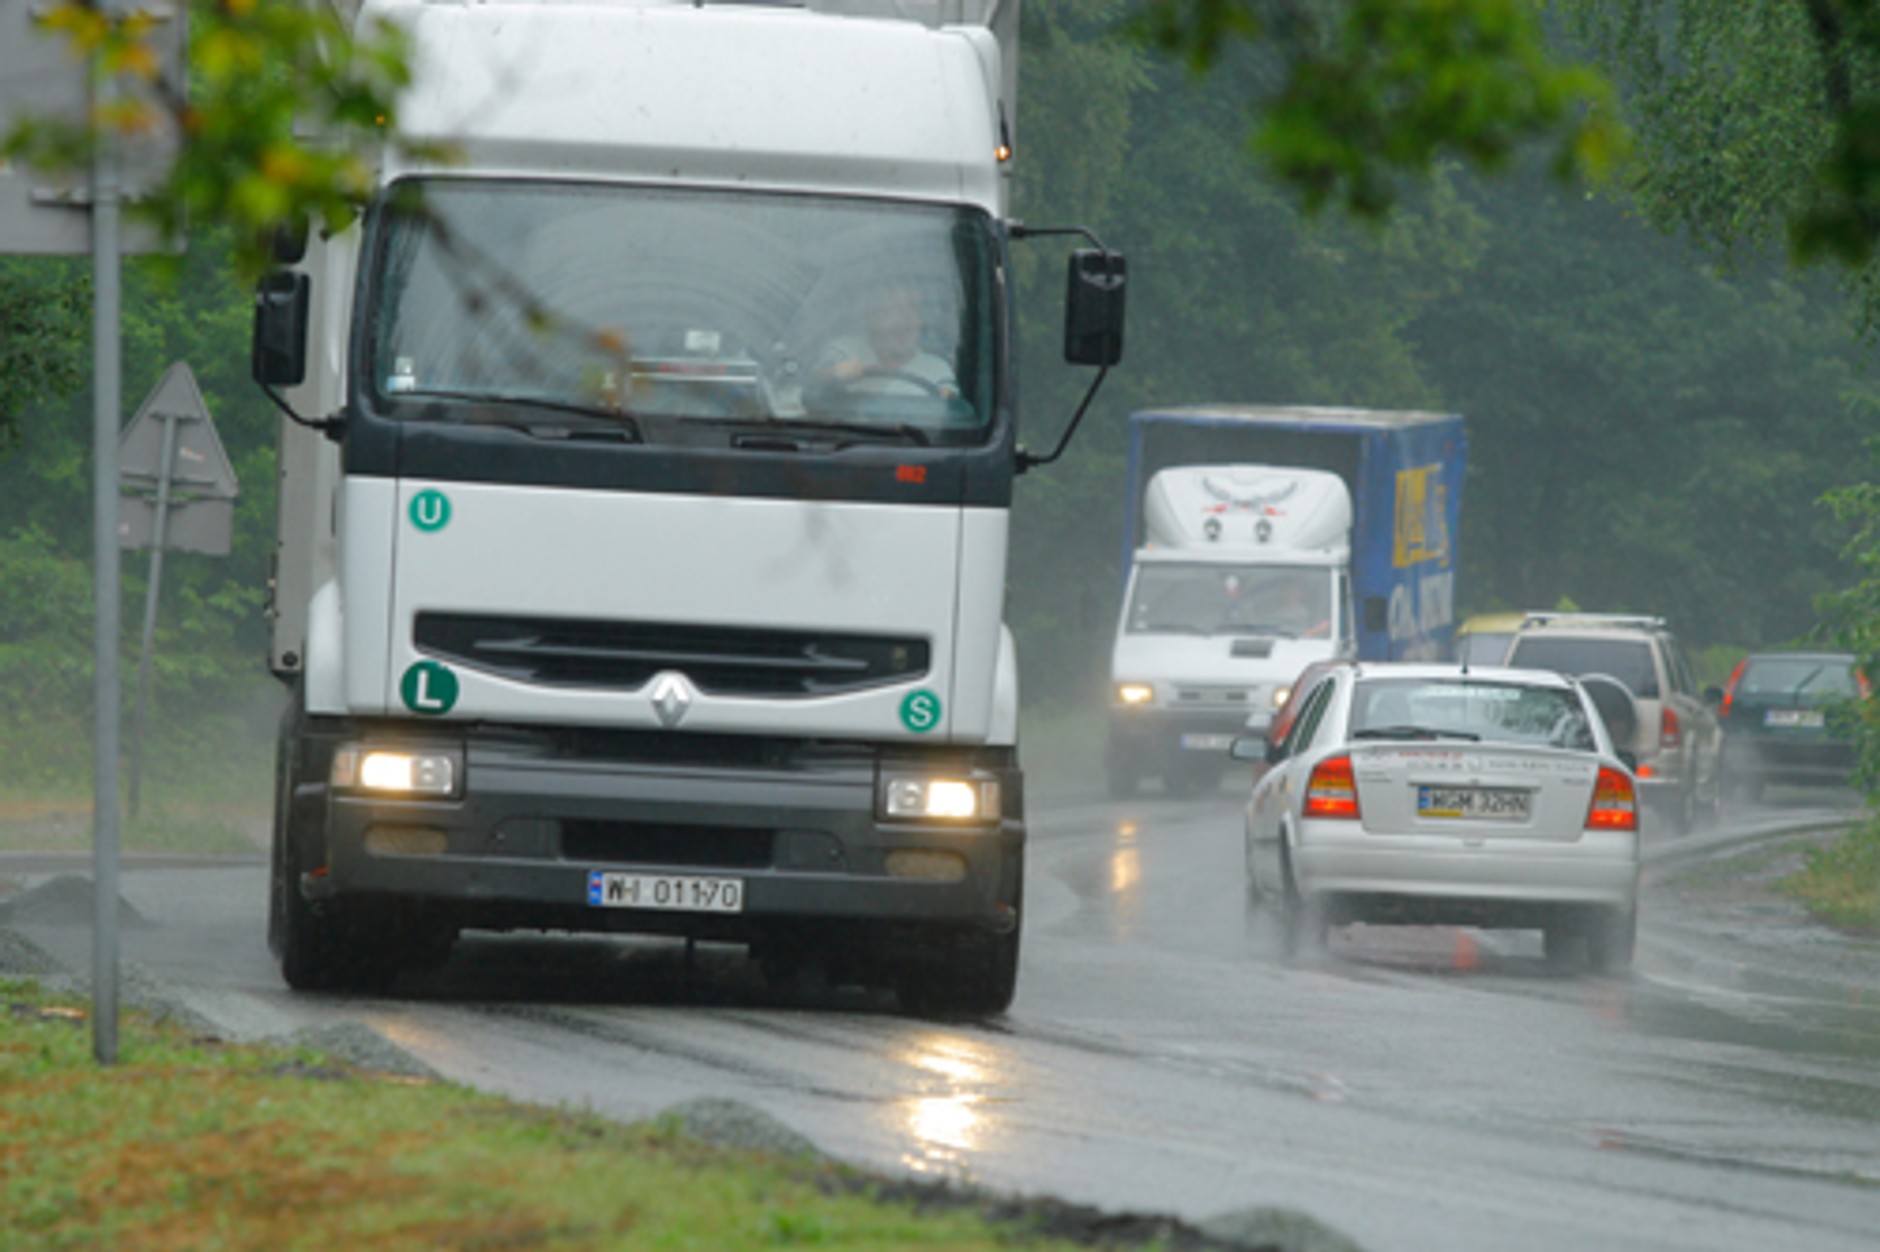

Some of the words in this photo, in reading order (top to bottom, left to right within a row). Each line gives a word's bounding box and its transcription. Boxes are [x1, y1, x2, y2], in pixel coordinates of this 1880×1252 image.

[417, 496, 442, 525] U
[415, 670, 443, 709] L
[909, 695, 932, 727] S
